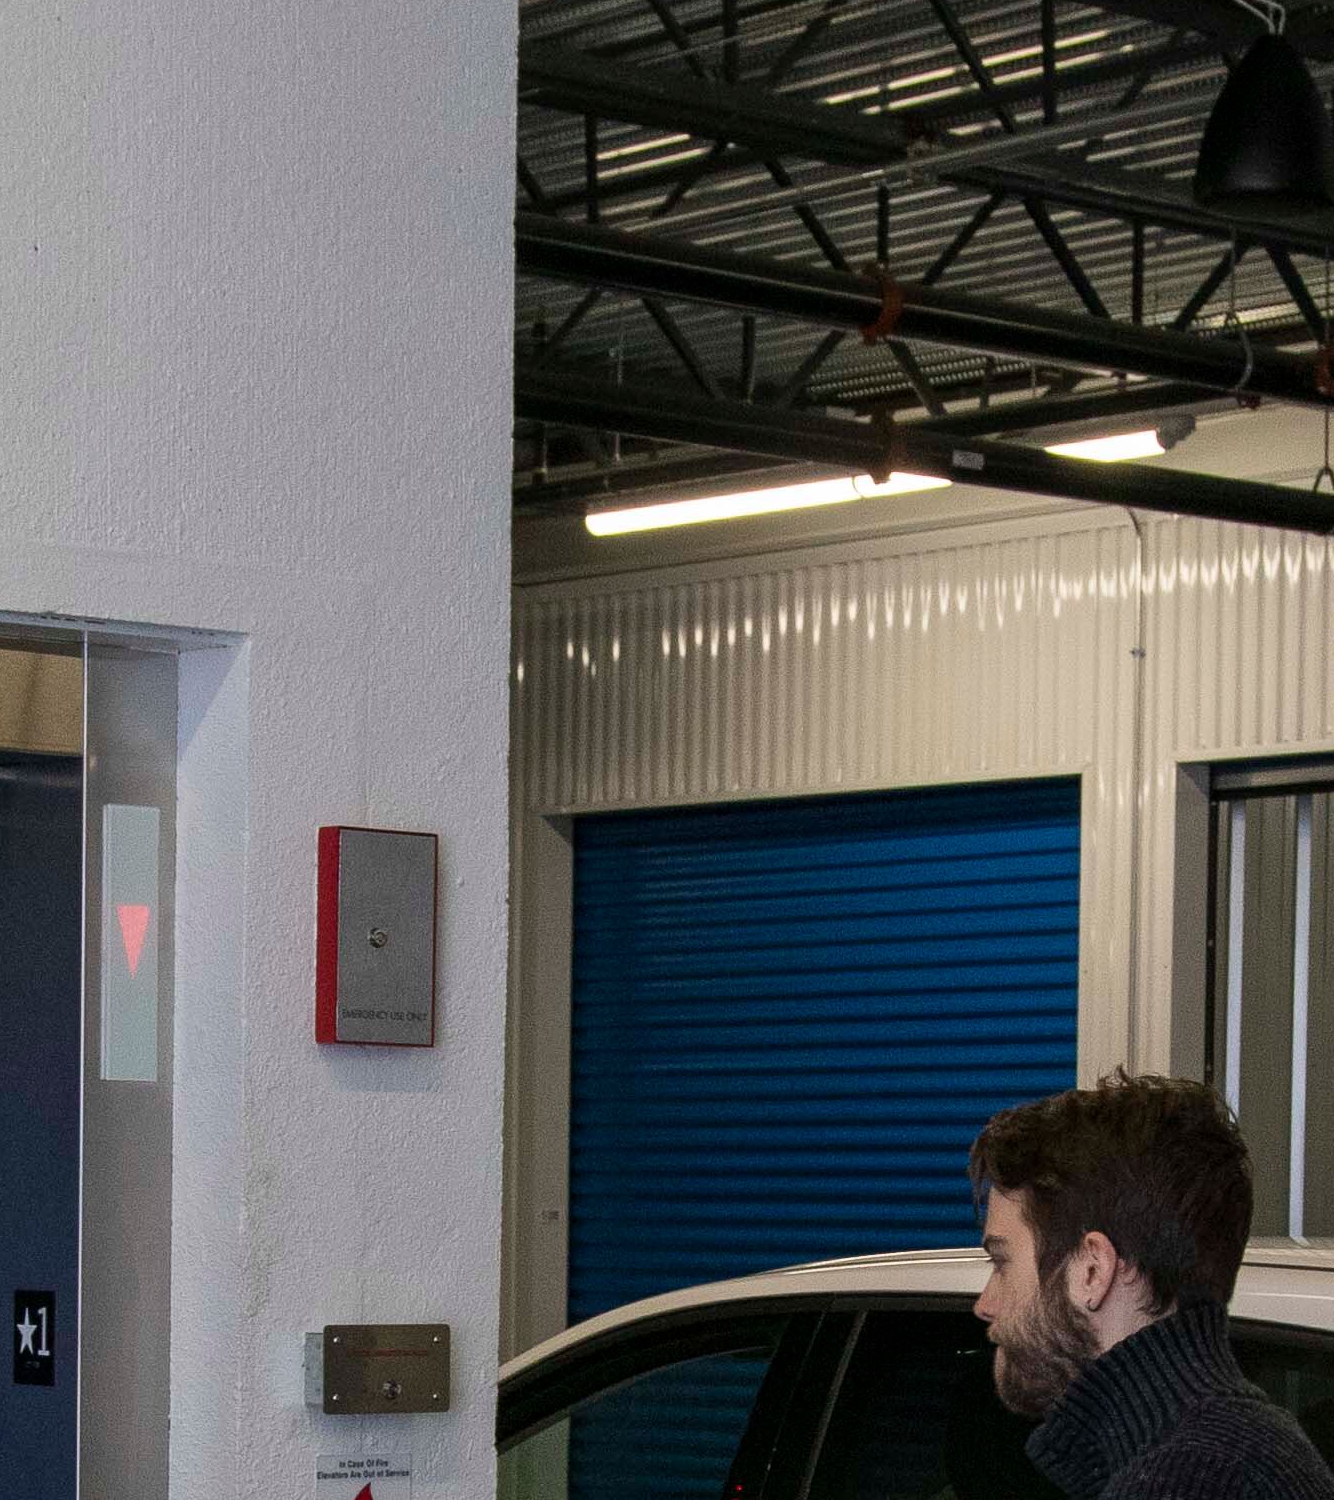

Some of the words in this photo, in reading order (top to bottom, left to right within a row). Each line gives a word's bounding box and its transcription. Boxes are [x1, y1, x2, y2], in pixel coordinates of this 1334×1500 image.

[342, 1008, 388, 1020] EMERGENCY
[390, 1011, 405, 1021] USE
[38, 1307, 50, 1356] 1
[347, 1459, 364, 1468] Case
[366, 1458, 375, 1467] Of
[375, 1458, 389, 1467] Fire
[317, 1470, 349, 1480] Elevators
[350, 1470, 362, 1479] Are
[363, 1469, 375, 1478] Out
[385, 1468, 410, 1478] Service
